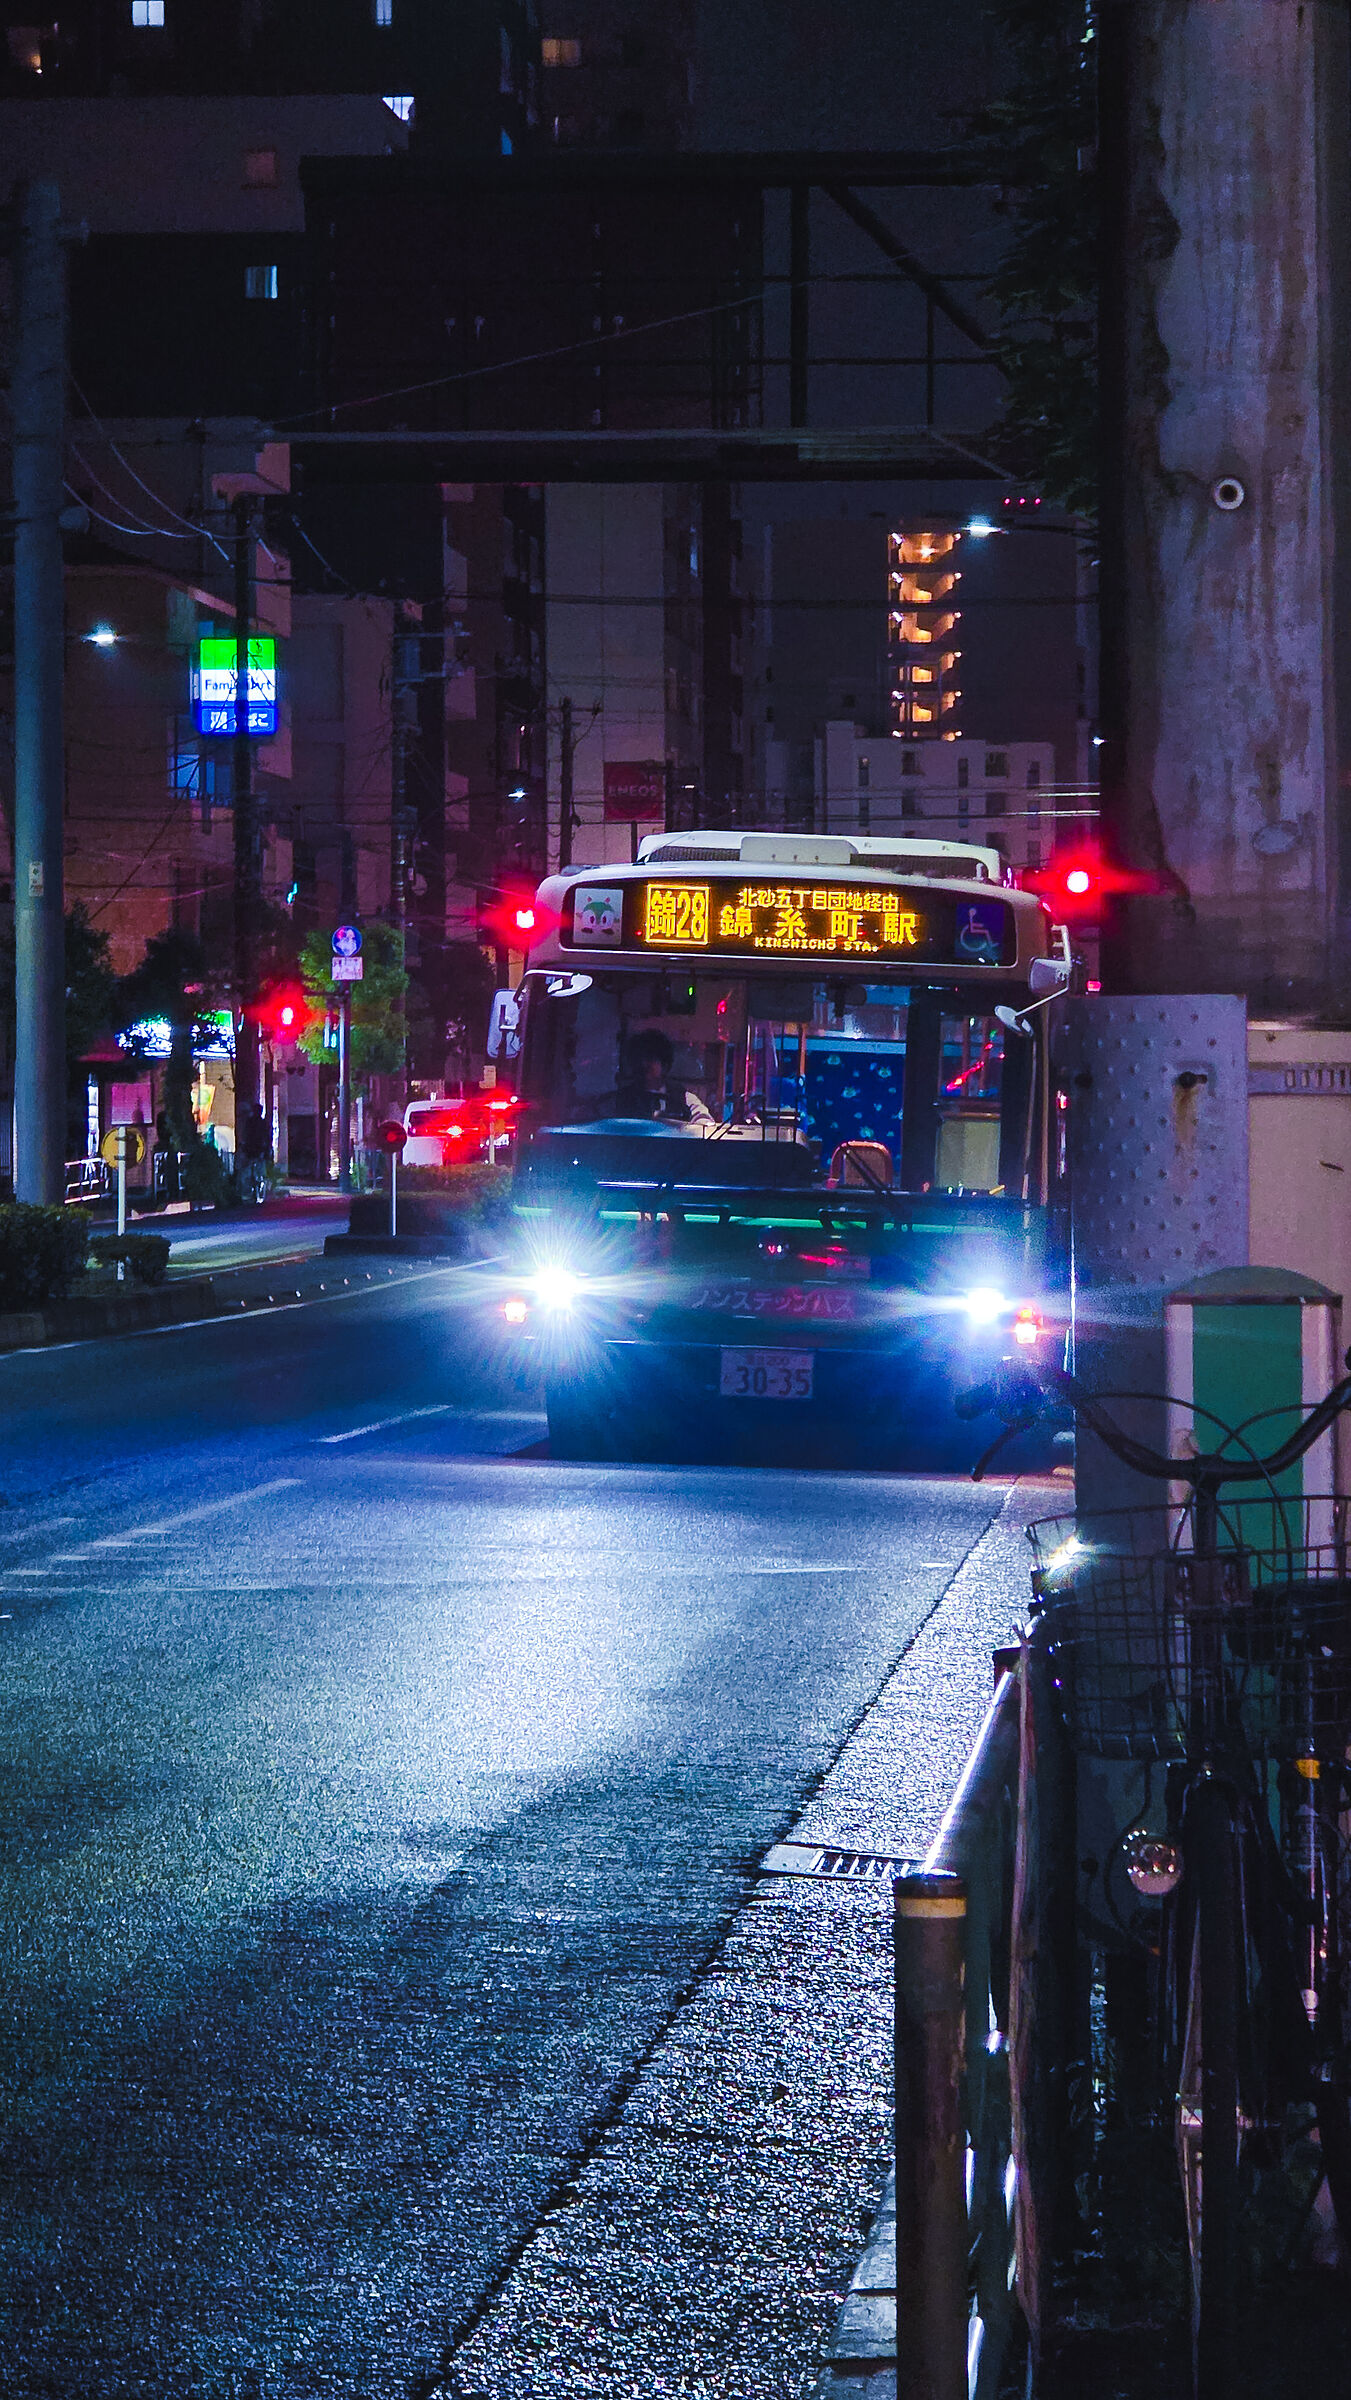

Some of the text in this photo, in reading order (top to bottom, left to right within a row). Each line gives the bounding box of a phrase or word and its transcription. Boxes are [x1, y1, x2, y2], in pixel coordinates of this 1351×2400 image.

[651, 891, 705, 938] 錦28
[739, 888, 900, 912] 北砂五丁目団地経由
[736, 1366, 809, 1395] 30-35
